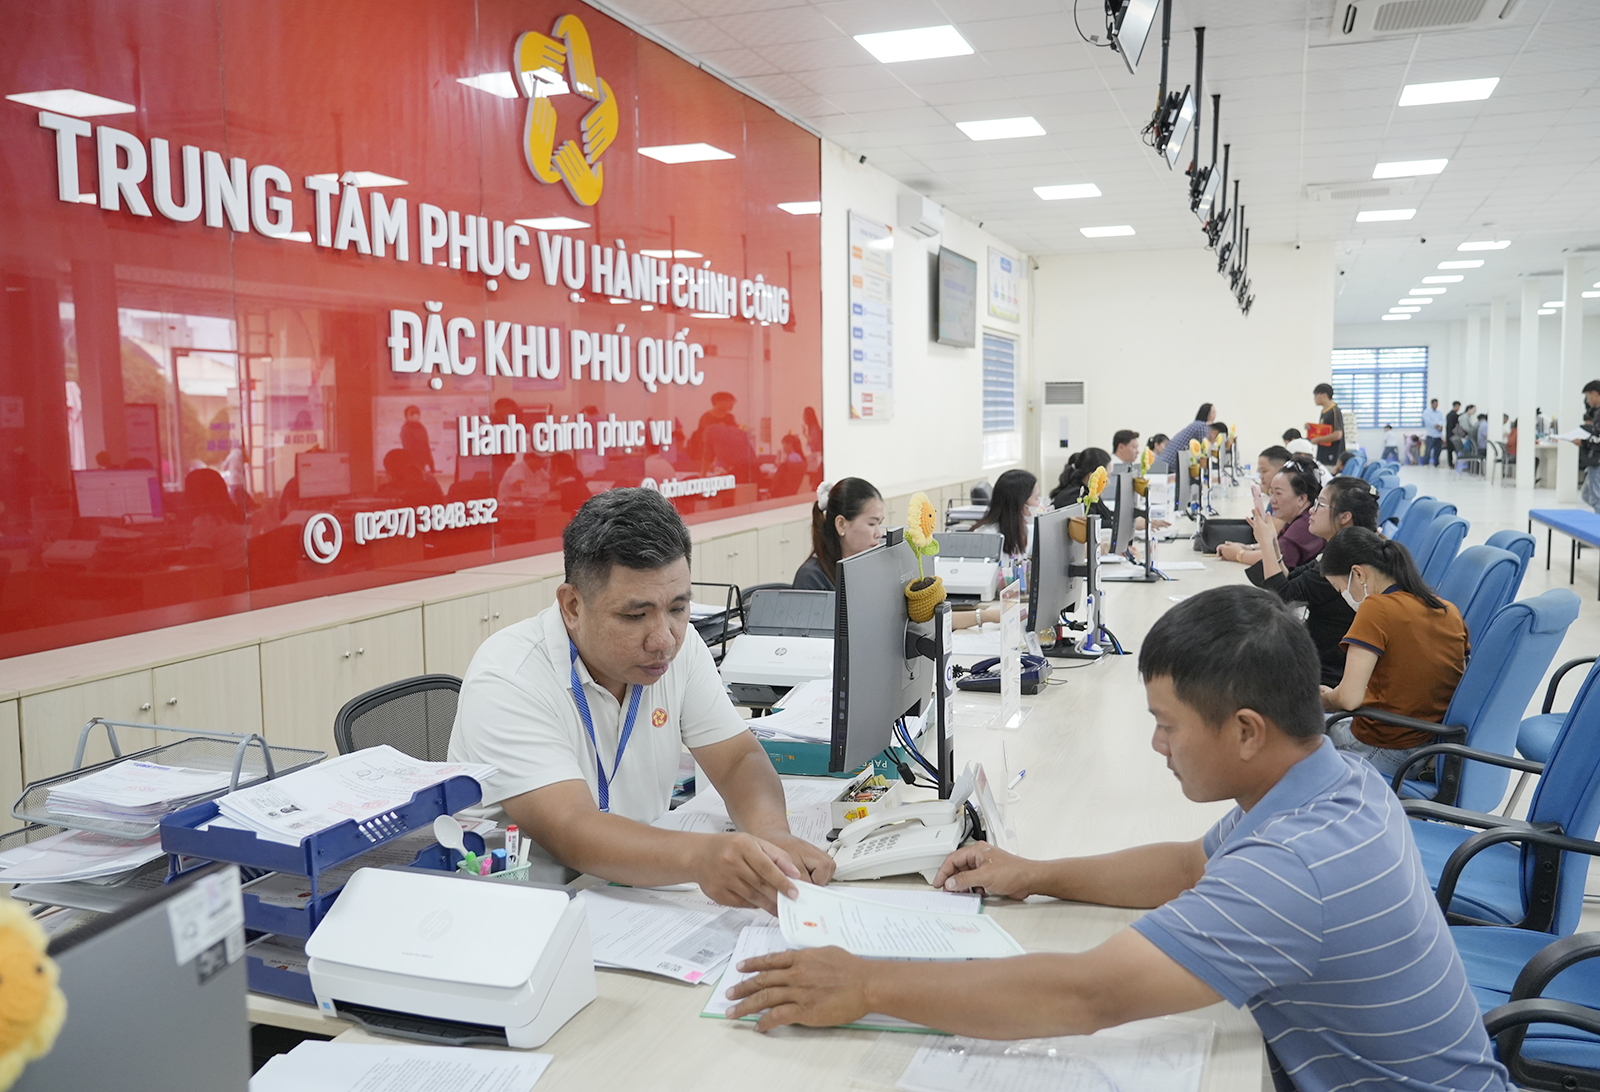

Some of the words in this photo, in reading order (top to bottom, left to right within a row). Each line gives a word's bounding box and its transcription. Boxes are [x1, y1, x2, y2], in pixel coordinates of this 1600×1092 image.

[38, 110, 294, 239] TRUNG
[304, 171, 410, 262] TÂM
[419, 203, 531, 292] PHỤC
[537, 231, 586, 303] VỤ
[591, 239, 668, 305] HÀNH
[671, 260, 738, 317] CHÍNH
[740, 273, 790, 325] CÔNG
[388, 301, 477, 390] ĐẶC
[484, 319, 561, 380] KHU
[570, 323, 632, 384] PHÚ
[638, 327, 705, 393] QUỐC
[459, 414, 527, 457] Hành
[532, 413, 593, 453] chính
[597, 412, 646, 457] phục
[649, 419, 673, 452] vụ
[354, 507, 416, 545] (0297)
